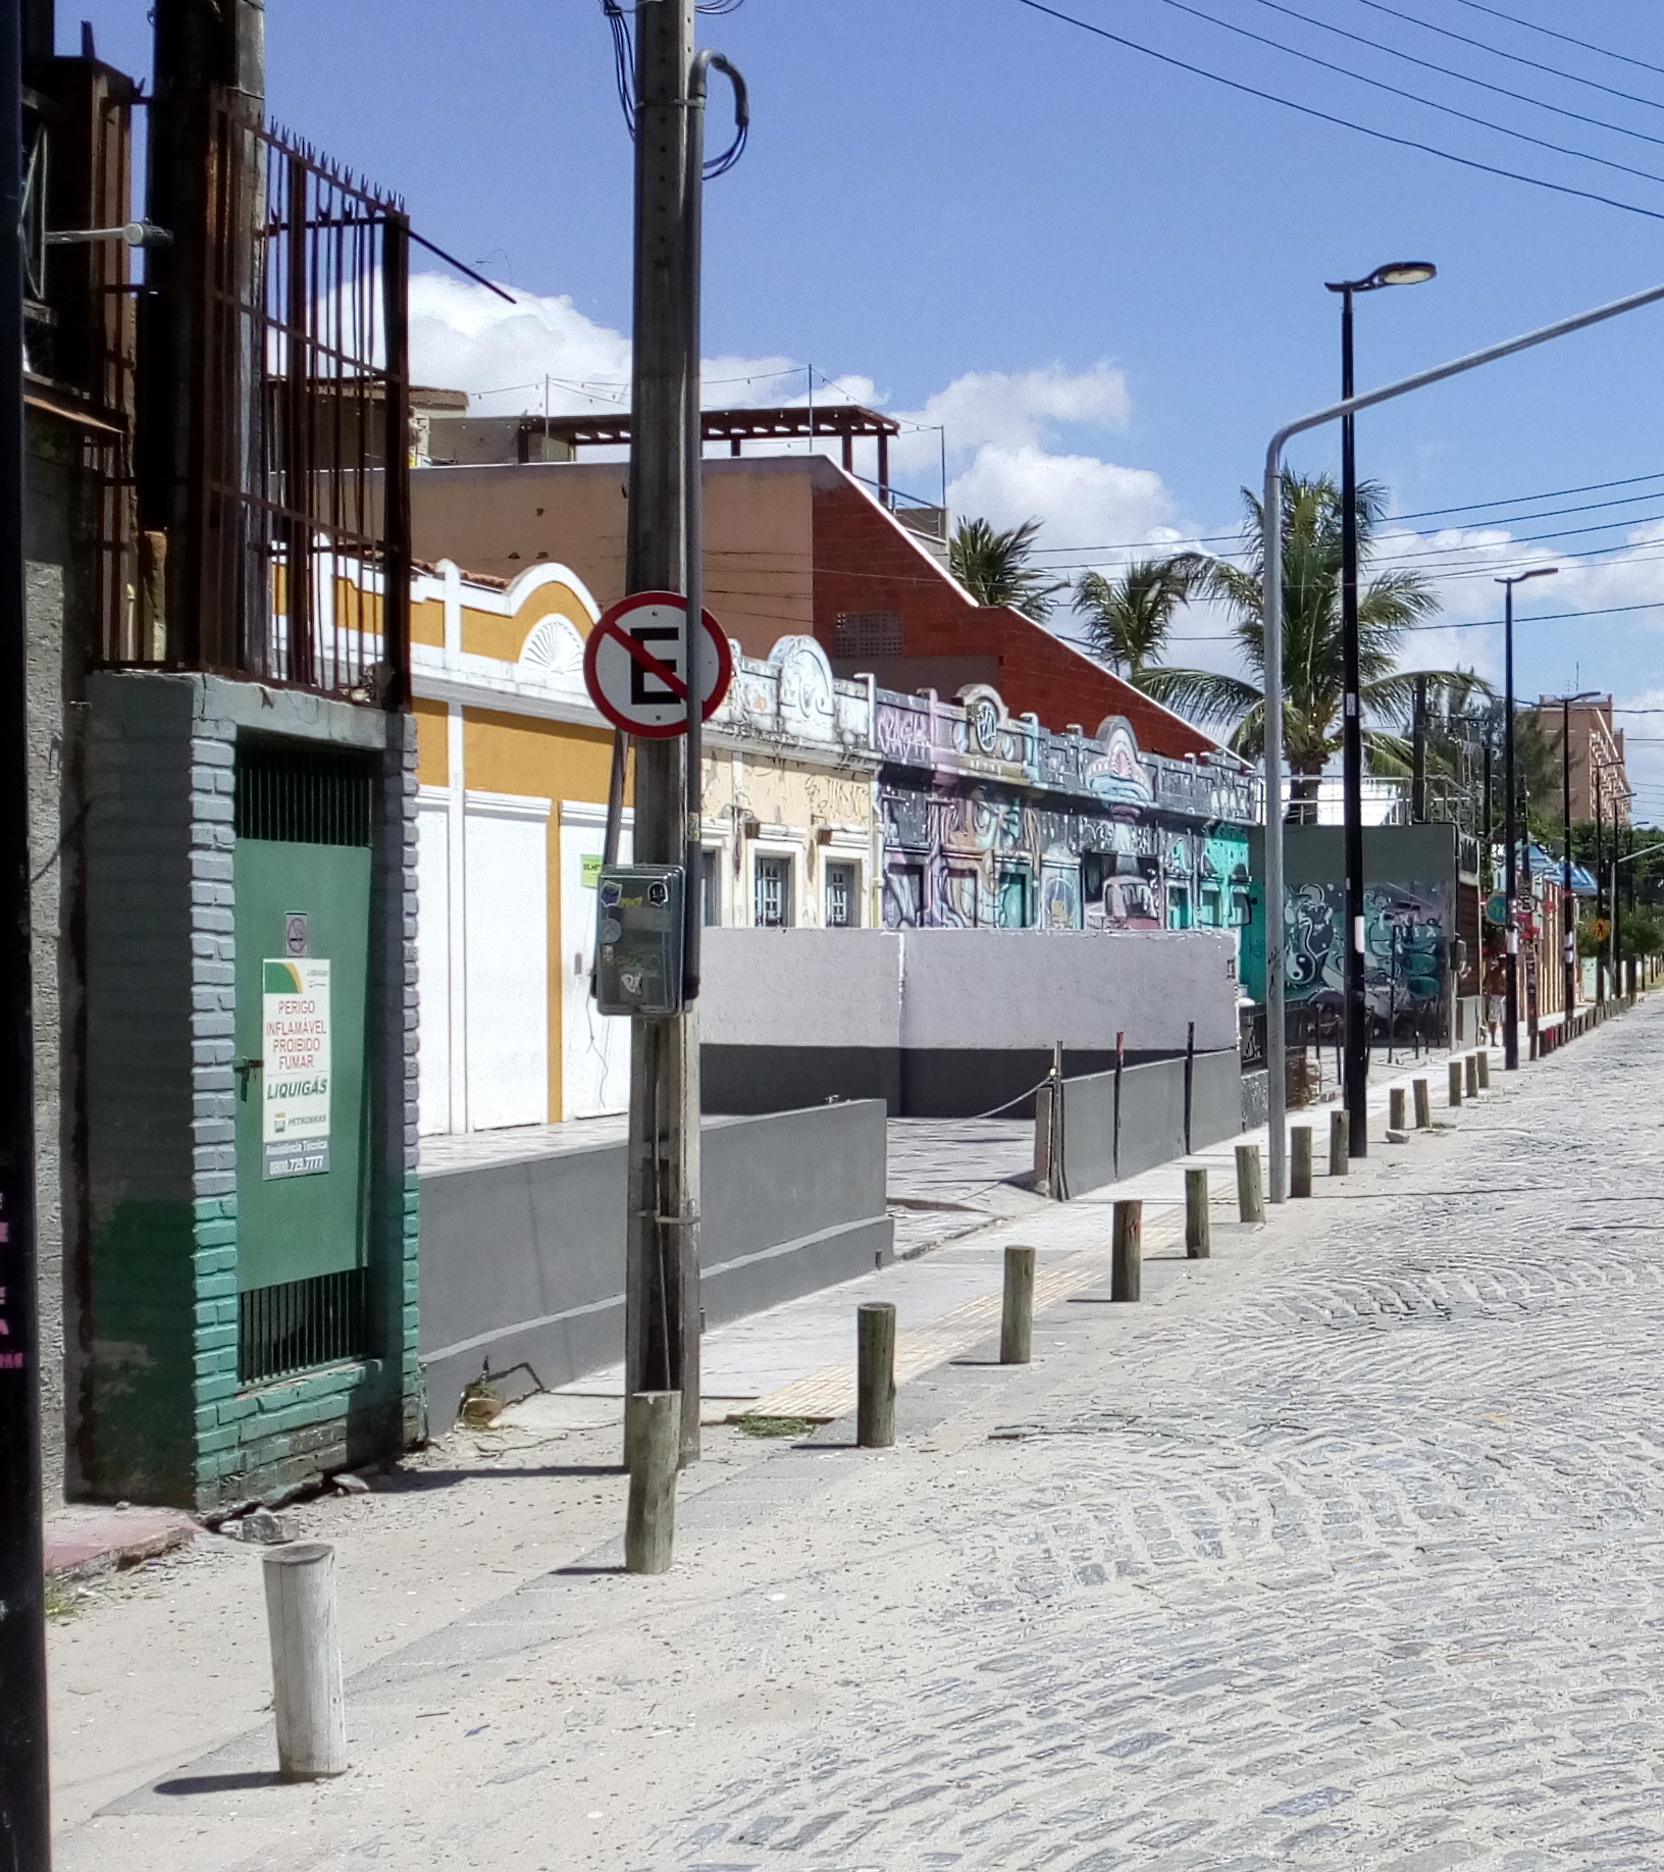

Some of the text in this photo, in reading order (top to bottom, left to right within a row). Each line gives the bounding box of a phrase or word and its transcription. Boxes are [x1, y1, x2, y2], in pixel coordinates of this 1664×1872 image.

[630, 627, 682, 705] E
[278, 1000, 316, 1015] PERIGO
[265, 1017, 327, 1036] INFLAMÁVEL
[273, 1038, 321, 1053] PROIBIDO
[279, 1054, 315, 1070] FUMAR
[266, 1075, 328, 1100] LIQUIGÁS
